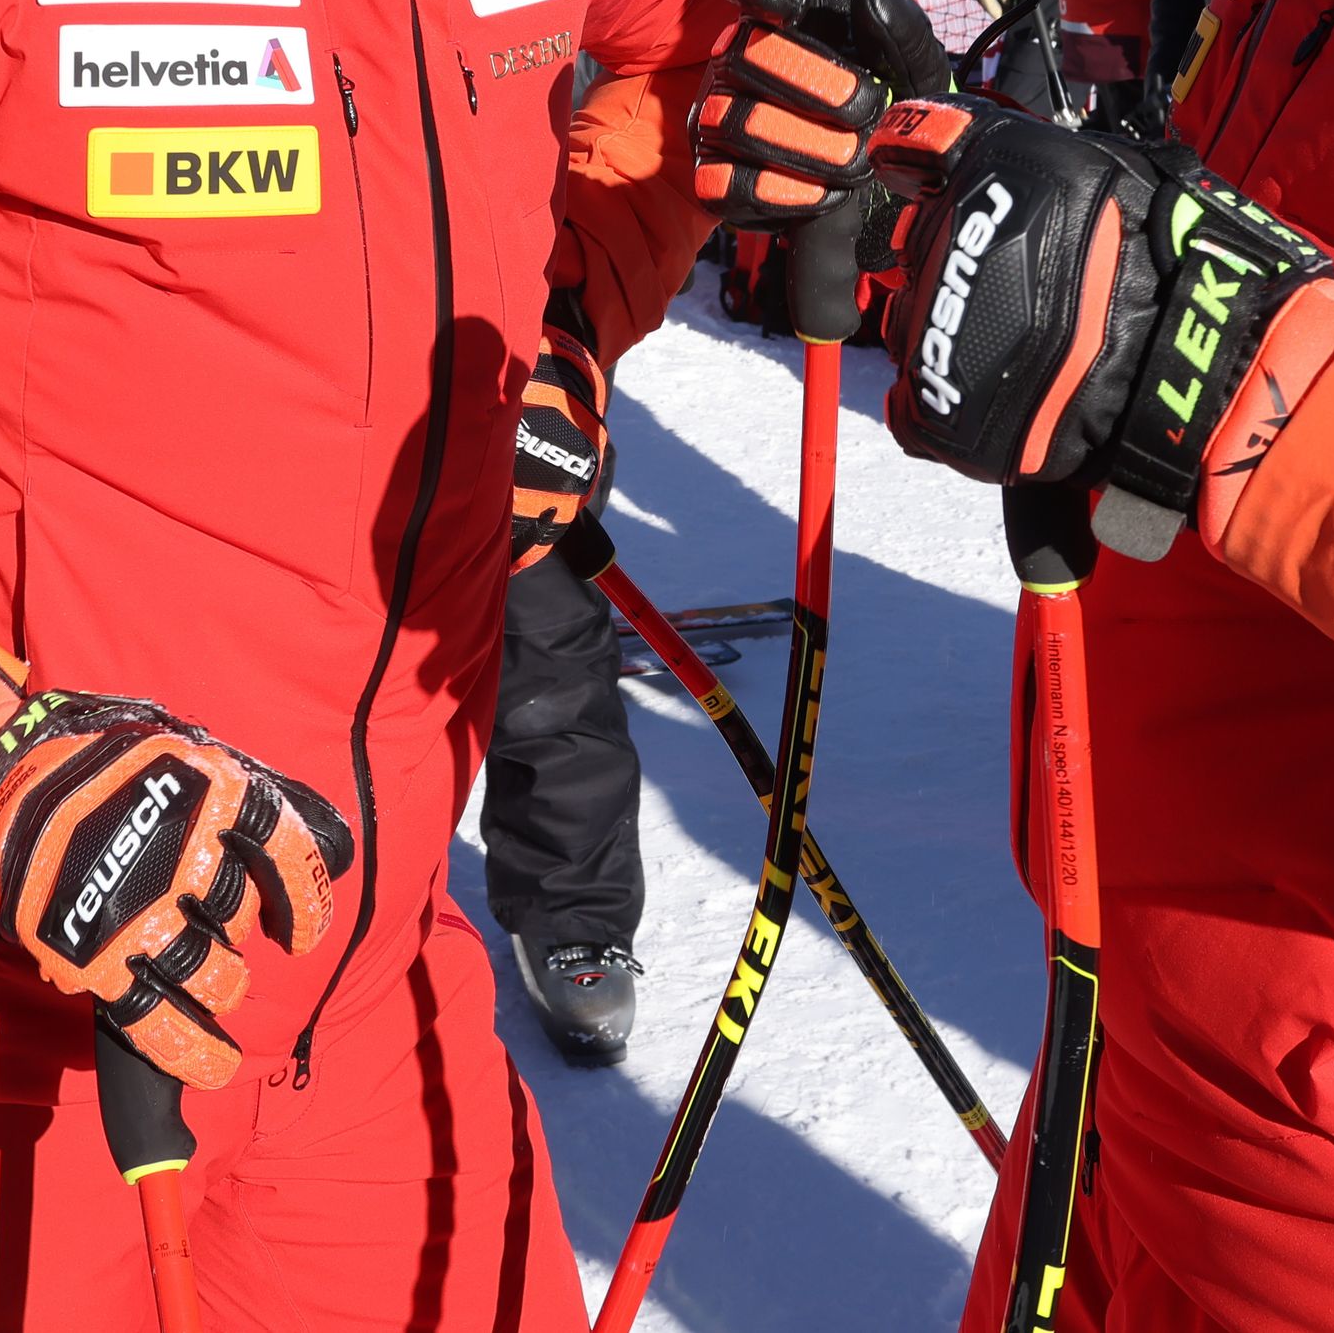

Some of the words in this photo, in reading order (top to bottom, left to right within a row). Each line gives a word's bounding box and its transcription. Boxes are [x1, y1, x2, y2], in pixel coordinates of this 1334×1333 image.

[73, 48, 249, 88] helvetia
[166, 149, 300, 195] BKW
[921, 181, 1014, 416] reusch
[1047, 632, 1065, 720] Hintermann
[63, 771, 182, 947] reusch
[305, 850, 332, 935] racing
[798, 830, 860, 932] EKI
[716, 856, 793, 1046] LEKI
